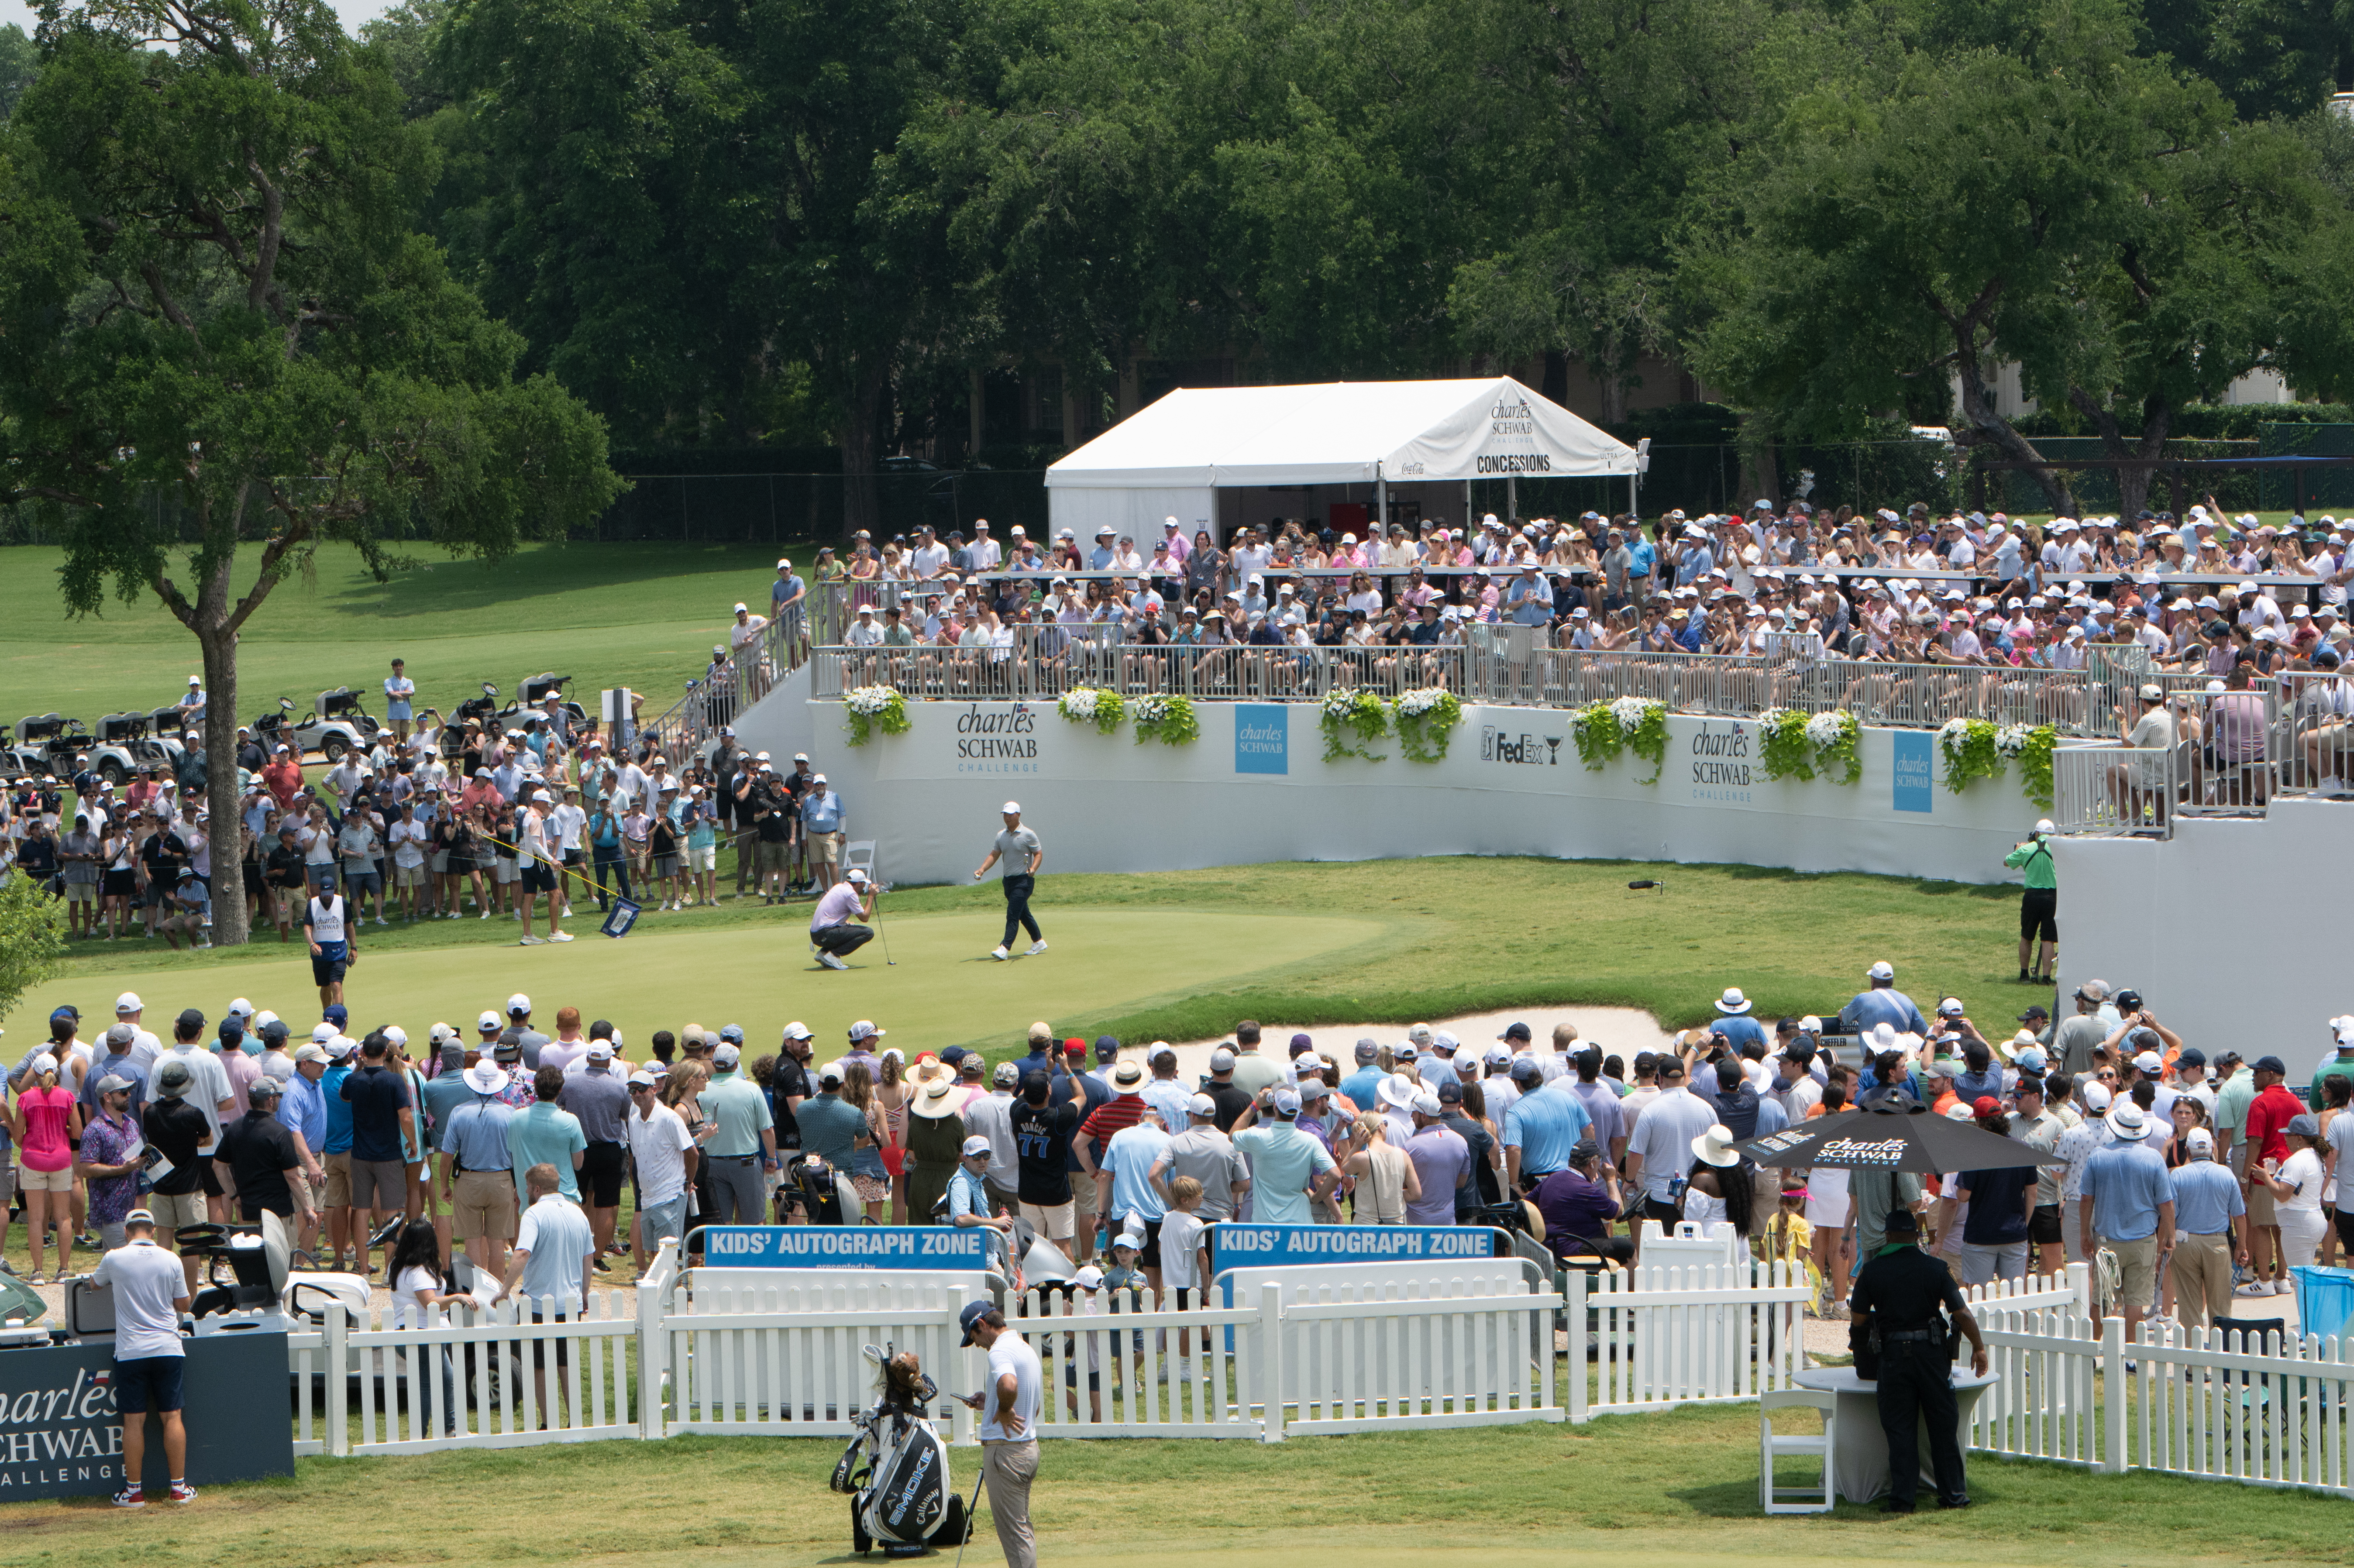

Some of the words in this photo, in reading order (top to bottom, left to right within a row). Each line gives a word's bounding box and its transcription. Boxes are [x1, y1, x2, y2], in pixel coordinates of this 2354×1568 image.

[1492, 398, 1531, 419] charles
[1493, 422, 1532, 435] SCHWAB
[1477, 454, 1550, 474] CONCESSIONS
[957, 703, 1035, 734] charles
[1240, 723, 1283, 741] charles
[1693, 722, 1749, 758] charles
[957, 739, 1038, 759] SCHWAB
[1239, 741, 1283, 754] SCHWAB
[1497, 732, 1543, 764] FedEx
[958, 763, 1038, 772] CHALLENGE
[1897, 753, 1929, 773] charles
[1693, 762, 1750, 786] SCHWAB
[1896, 774, 1929, 789] SCHWAB
[1693, 789, 1751, 802] CHALLENGE
[316, 916, 339, 925] charles
[1818, 1038, 1847, 1047] CHEFFLER
[1020, 1122, 1047, 1135] DONČIĆ
[1018, 1132, 1050, 1158] 77
[1824, 1137, 1908, 1151] charles
[1817, 1149, 1902, 1160] SCHWAB
[778, 1233, 914, 1255] AUTOGRAPH
[922, 1234, 980, 1255] ZONE
[1287, 1231, 1422, 1254] AUTOGRAPH
[1429, 1234, 1488, 1255] ZONE
[0, 1426, 124, 1463] HWAB
[889, 1446, 935, 1526] SMOKE
[886, 1491, 898, 1510] Ai
[917, 1488, 939, 1524] Callaway
